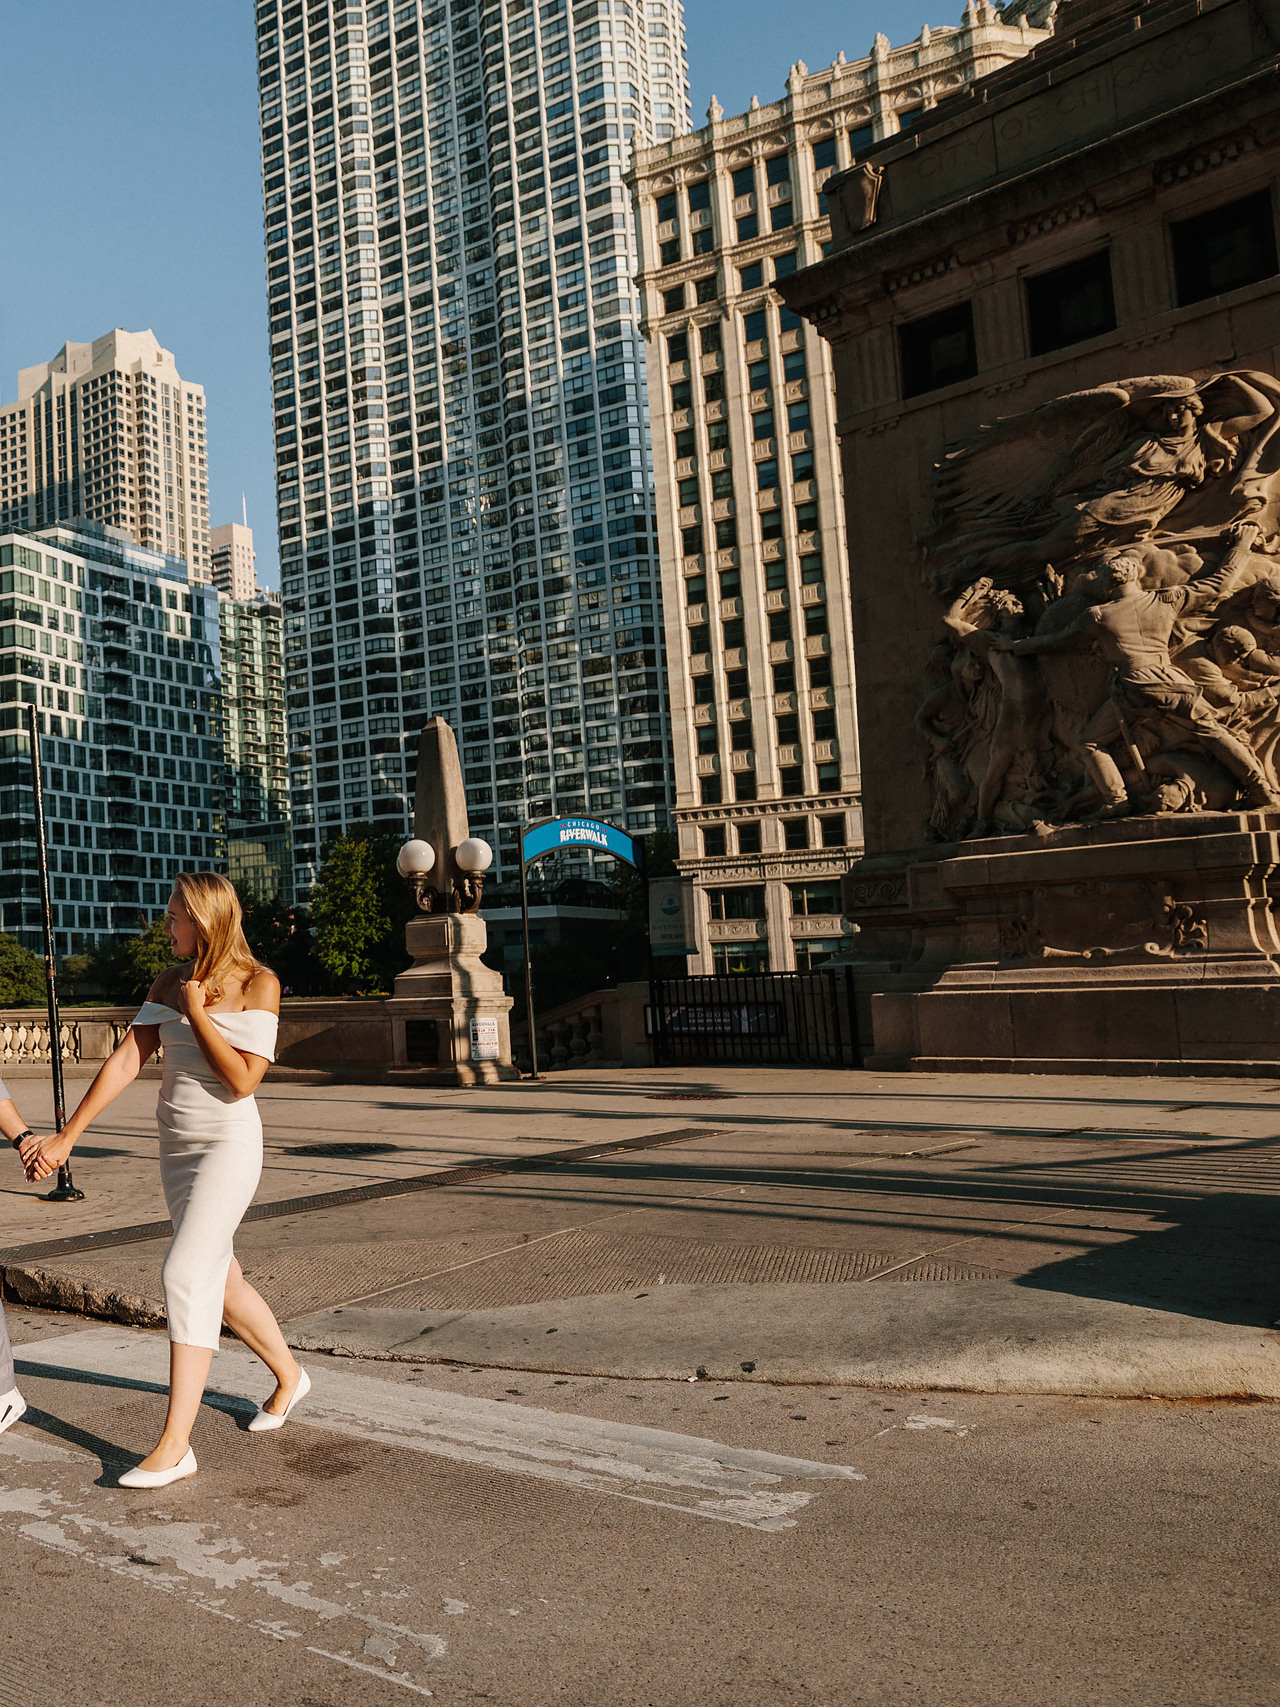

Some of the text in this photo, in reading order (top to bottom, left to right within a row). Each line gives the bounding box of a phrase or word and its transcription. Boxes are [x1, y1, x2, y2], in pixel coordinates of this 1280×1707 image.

[918, 31, 1212, 177] CITY OF CHICAGO
[567, 821, 600, 830] CHICAGO
[559, 828, 608, 846] RIVERWALK
